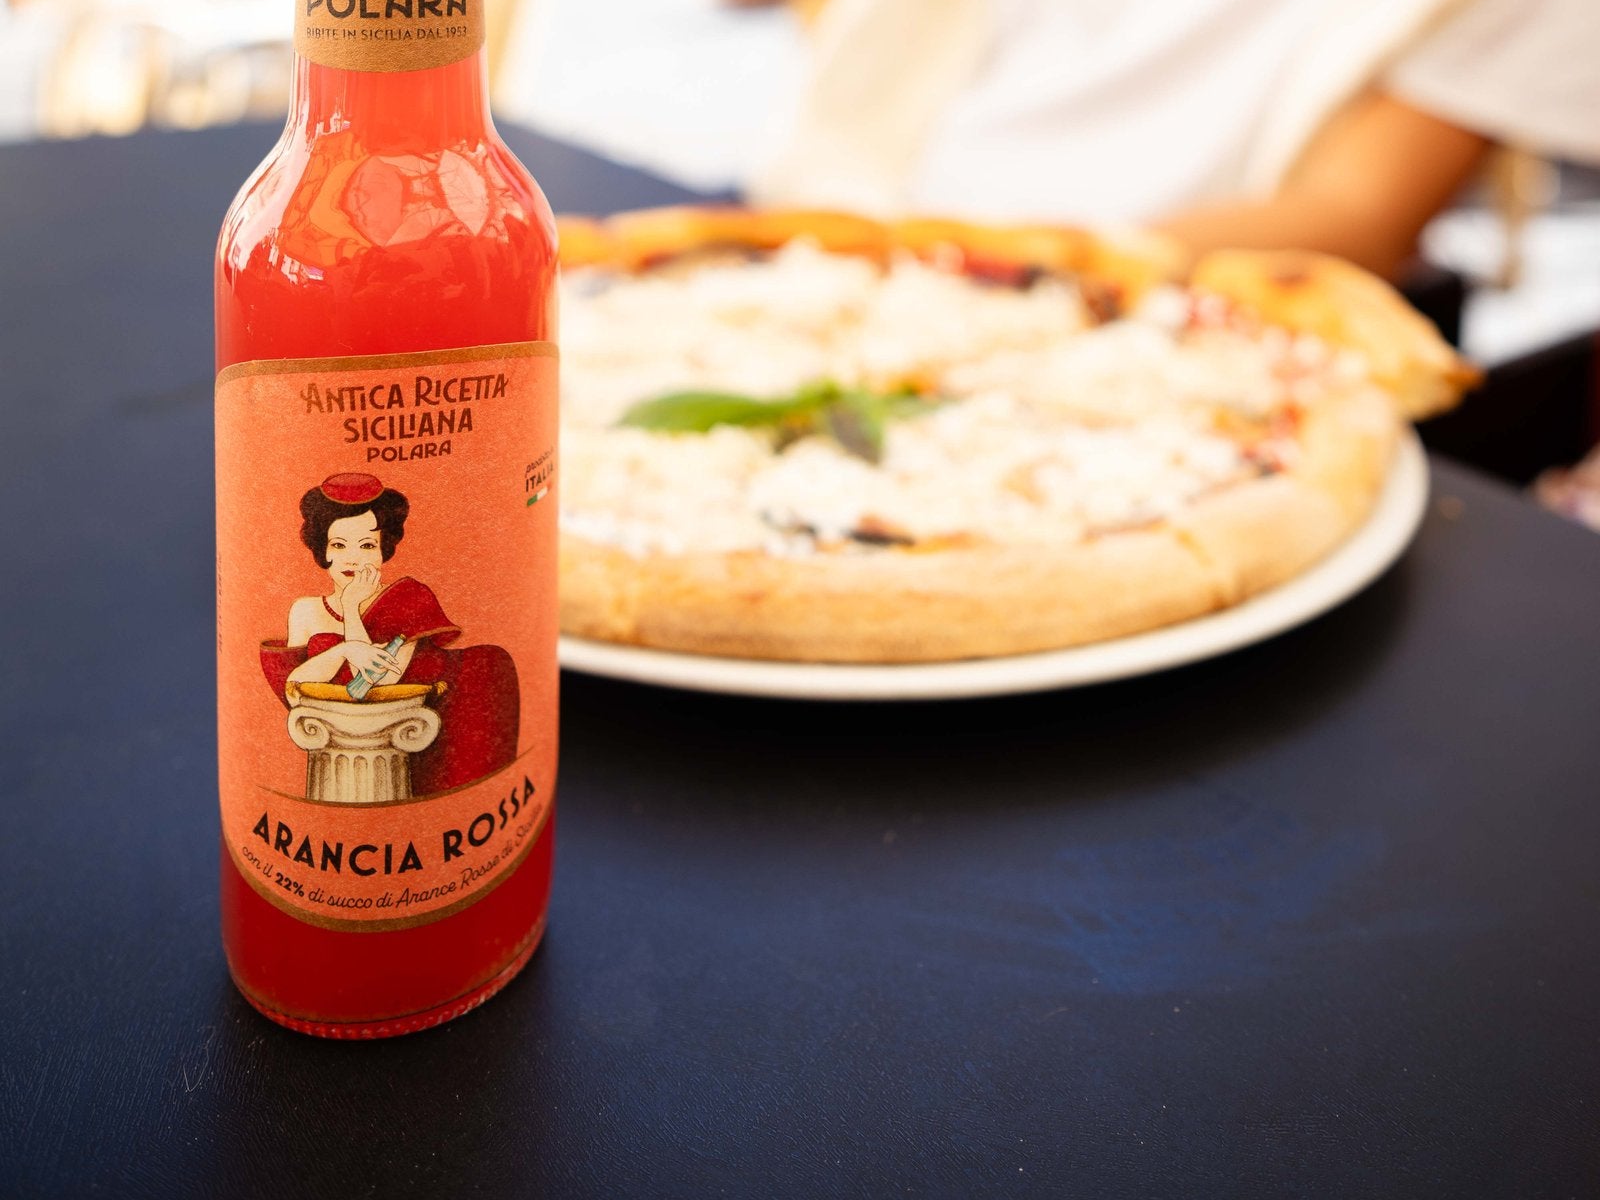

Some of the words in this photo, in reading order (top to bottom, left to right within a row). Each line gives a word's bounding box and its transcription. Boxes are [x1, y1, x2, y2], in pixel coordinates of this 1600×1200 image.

[306, 26, 339, 40] BIBITE
[343, 29, 356, 40] IN
[361, 29, 412, 41] SICILIA
[417, 28, 442, 40] DAL
[446, 26, 467, 39] 1953
[300, 383, 405, 414] ANTICA
[414, 373, 510, 407] RICETTA
[343, 407, 474, 444] SICILIANA
[366, 440, 452, 463] POLARA
[252, 810, 424, 877] ARANCIA
[442, 775, 536, 863] ROSSA
[242, 846, 262, 870] con
[262, 863, 272, 879] il
[274, 871, 305, 898] 22%
[308, 887, 325, 904] di
[326, 895, 374, 909] succo
[376, 891, 394, 909] di
[394, 880, 458, 909] Arance
[460, 854, 501, 890] Rosse
